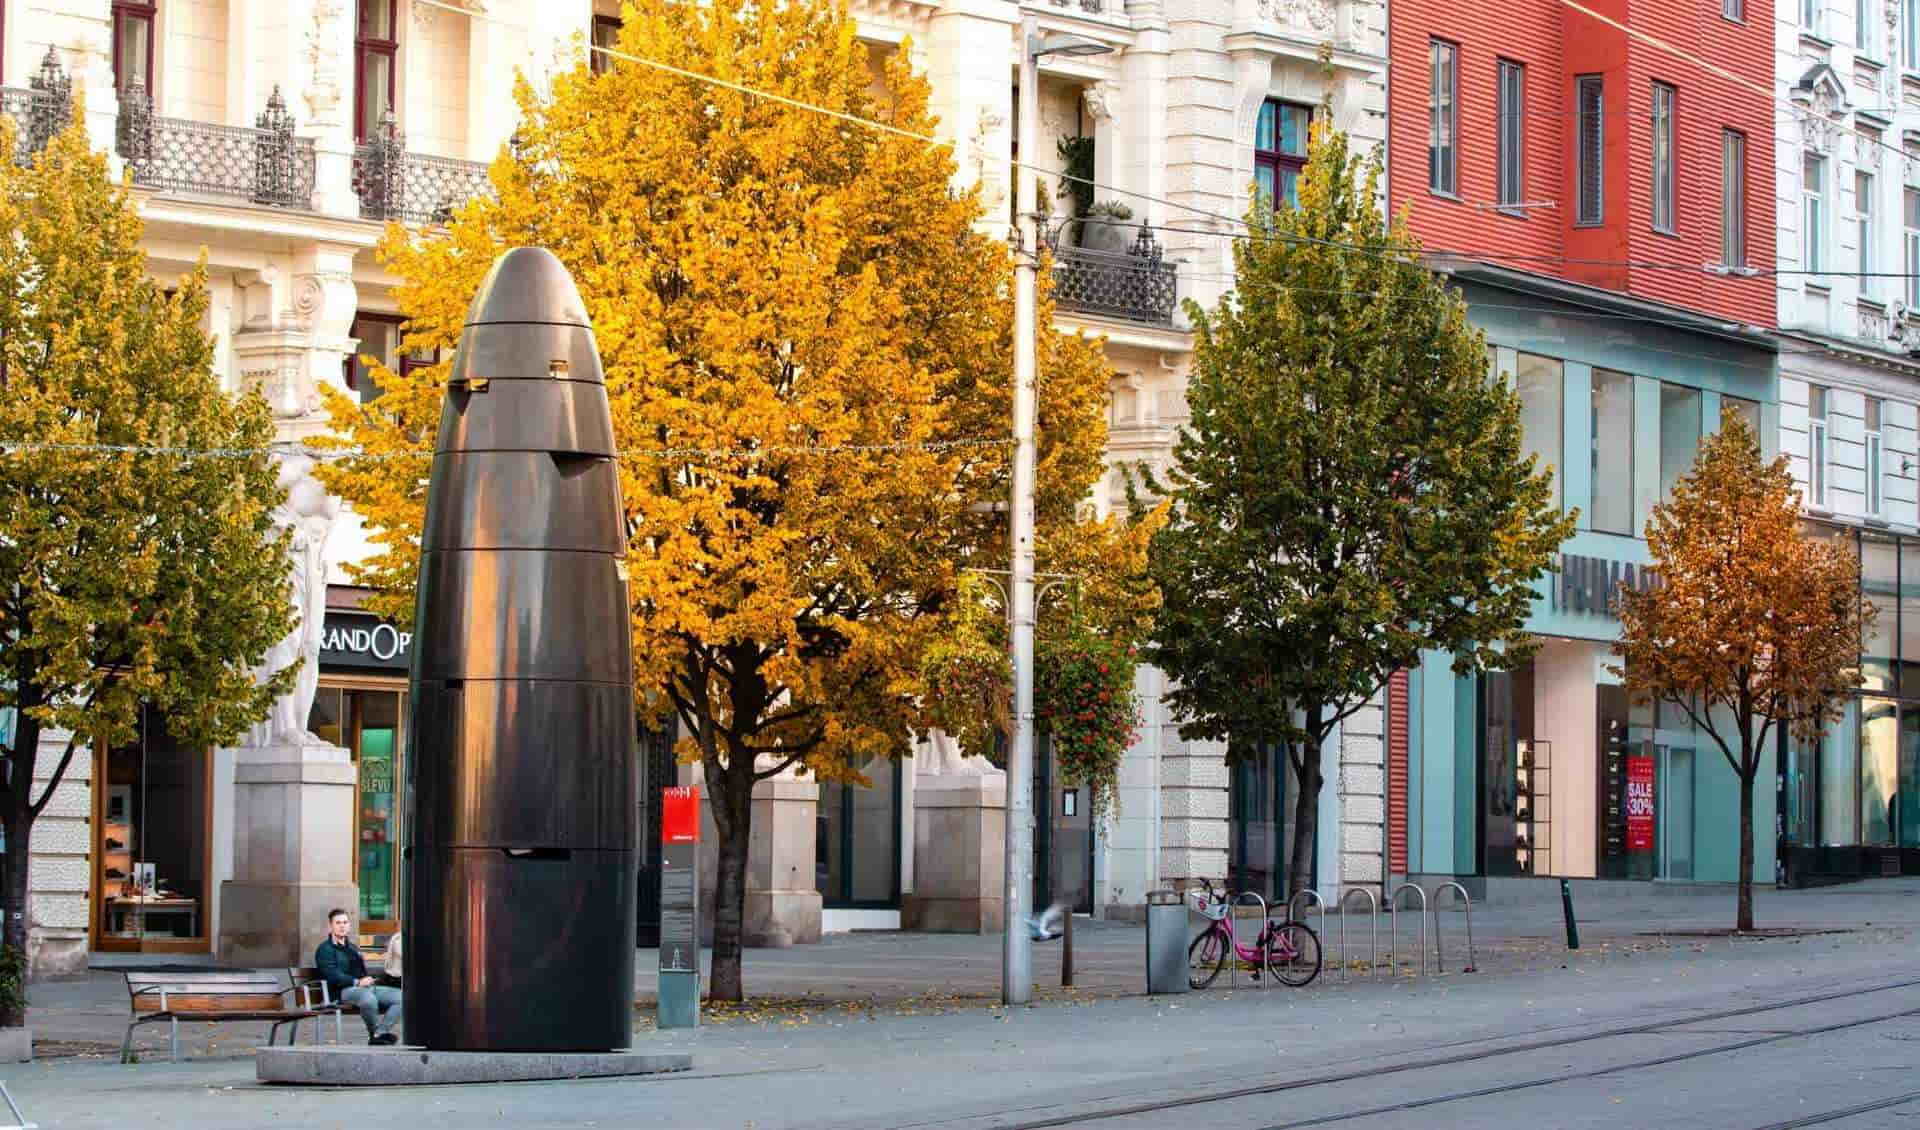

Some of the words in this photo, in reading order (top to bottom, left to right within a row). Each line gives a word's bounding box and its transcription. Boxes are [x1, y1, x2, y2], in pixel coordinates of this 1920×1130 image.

[320, 623, 413, 660] RANDOP
[1628, 783, 1653, 798] SALE
[1627, 798, 1654, 815] -30%
